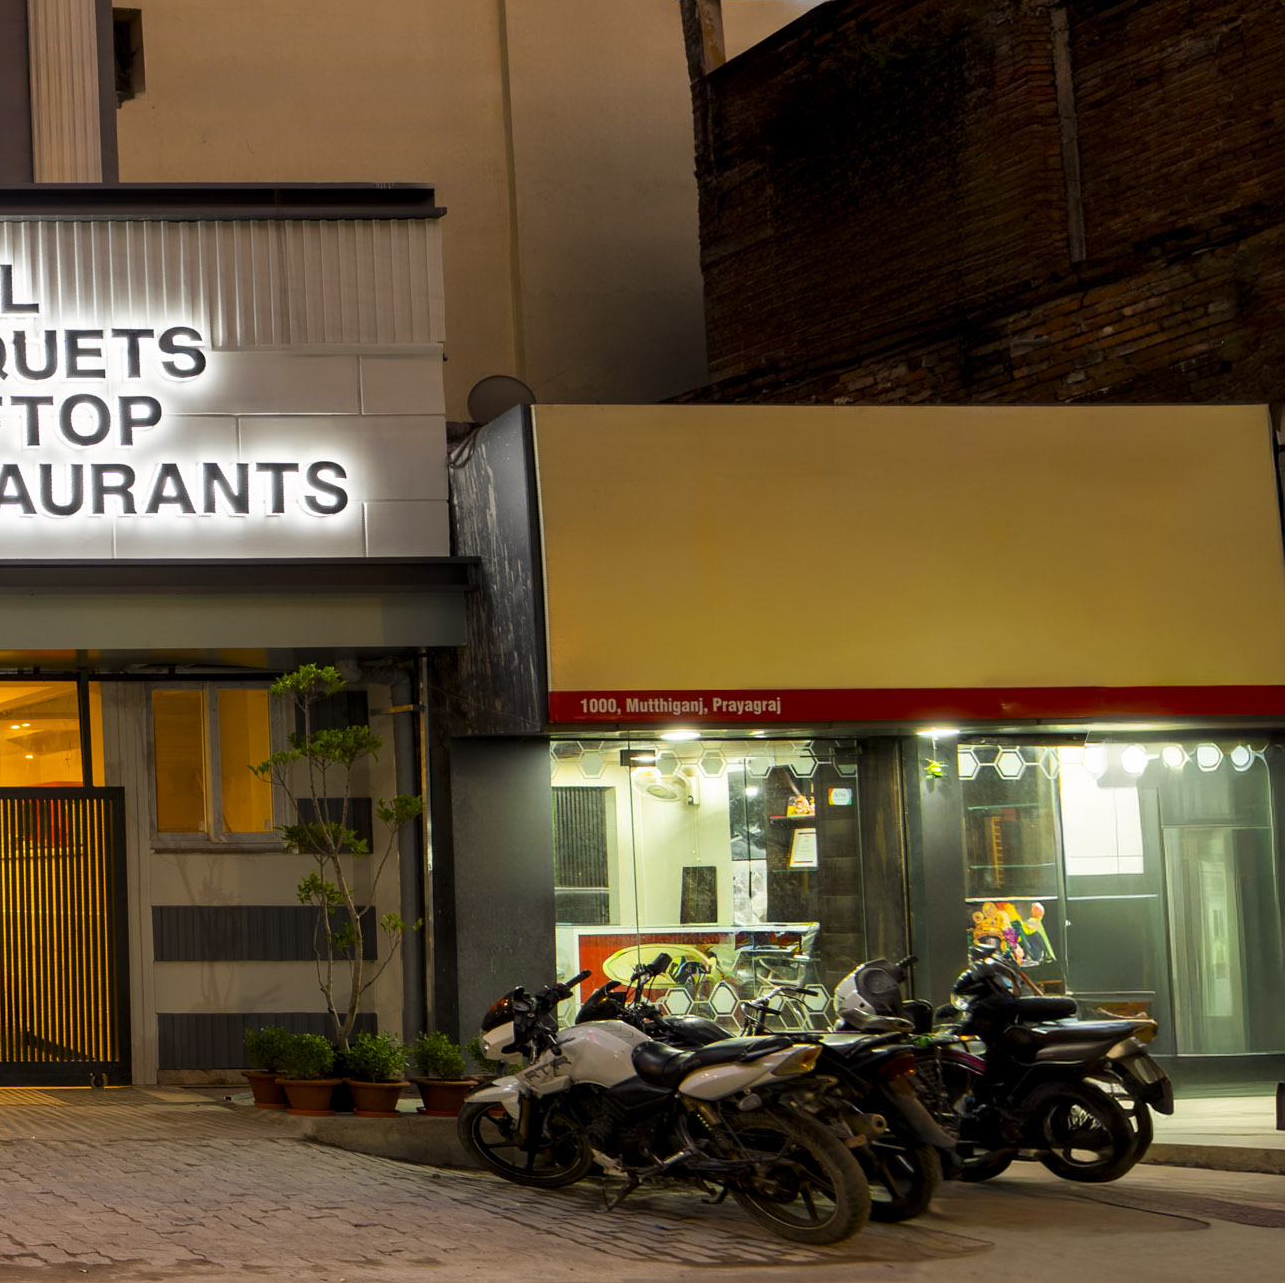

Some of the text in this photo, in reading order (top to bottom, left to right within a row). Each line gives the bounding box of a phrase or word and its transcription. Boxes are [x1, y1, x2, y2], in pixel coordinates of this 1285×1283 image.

[580, 697, 782, 716] 1000, Mutthiganj, Prayagraj
